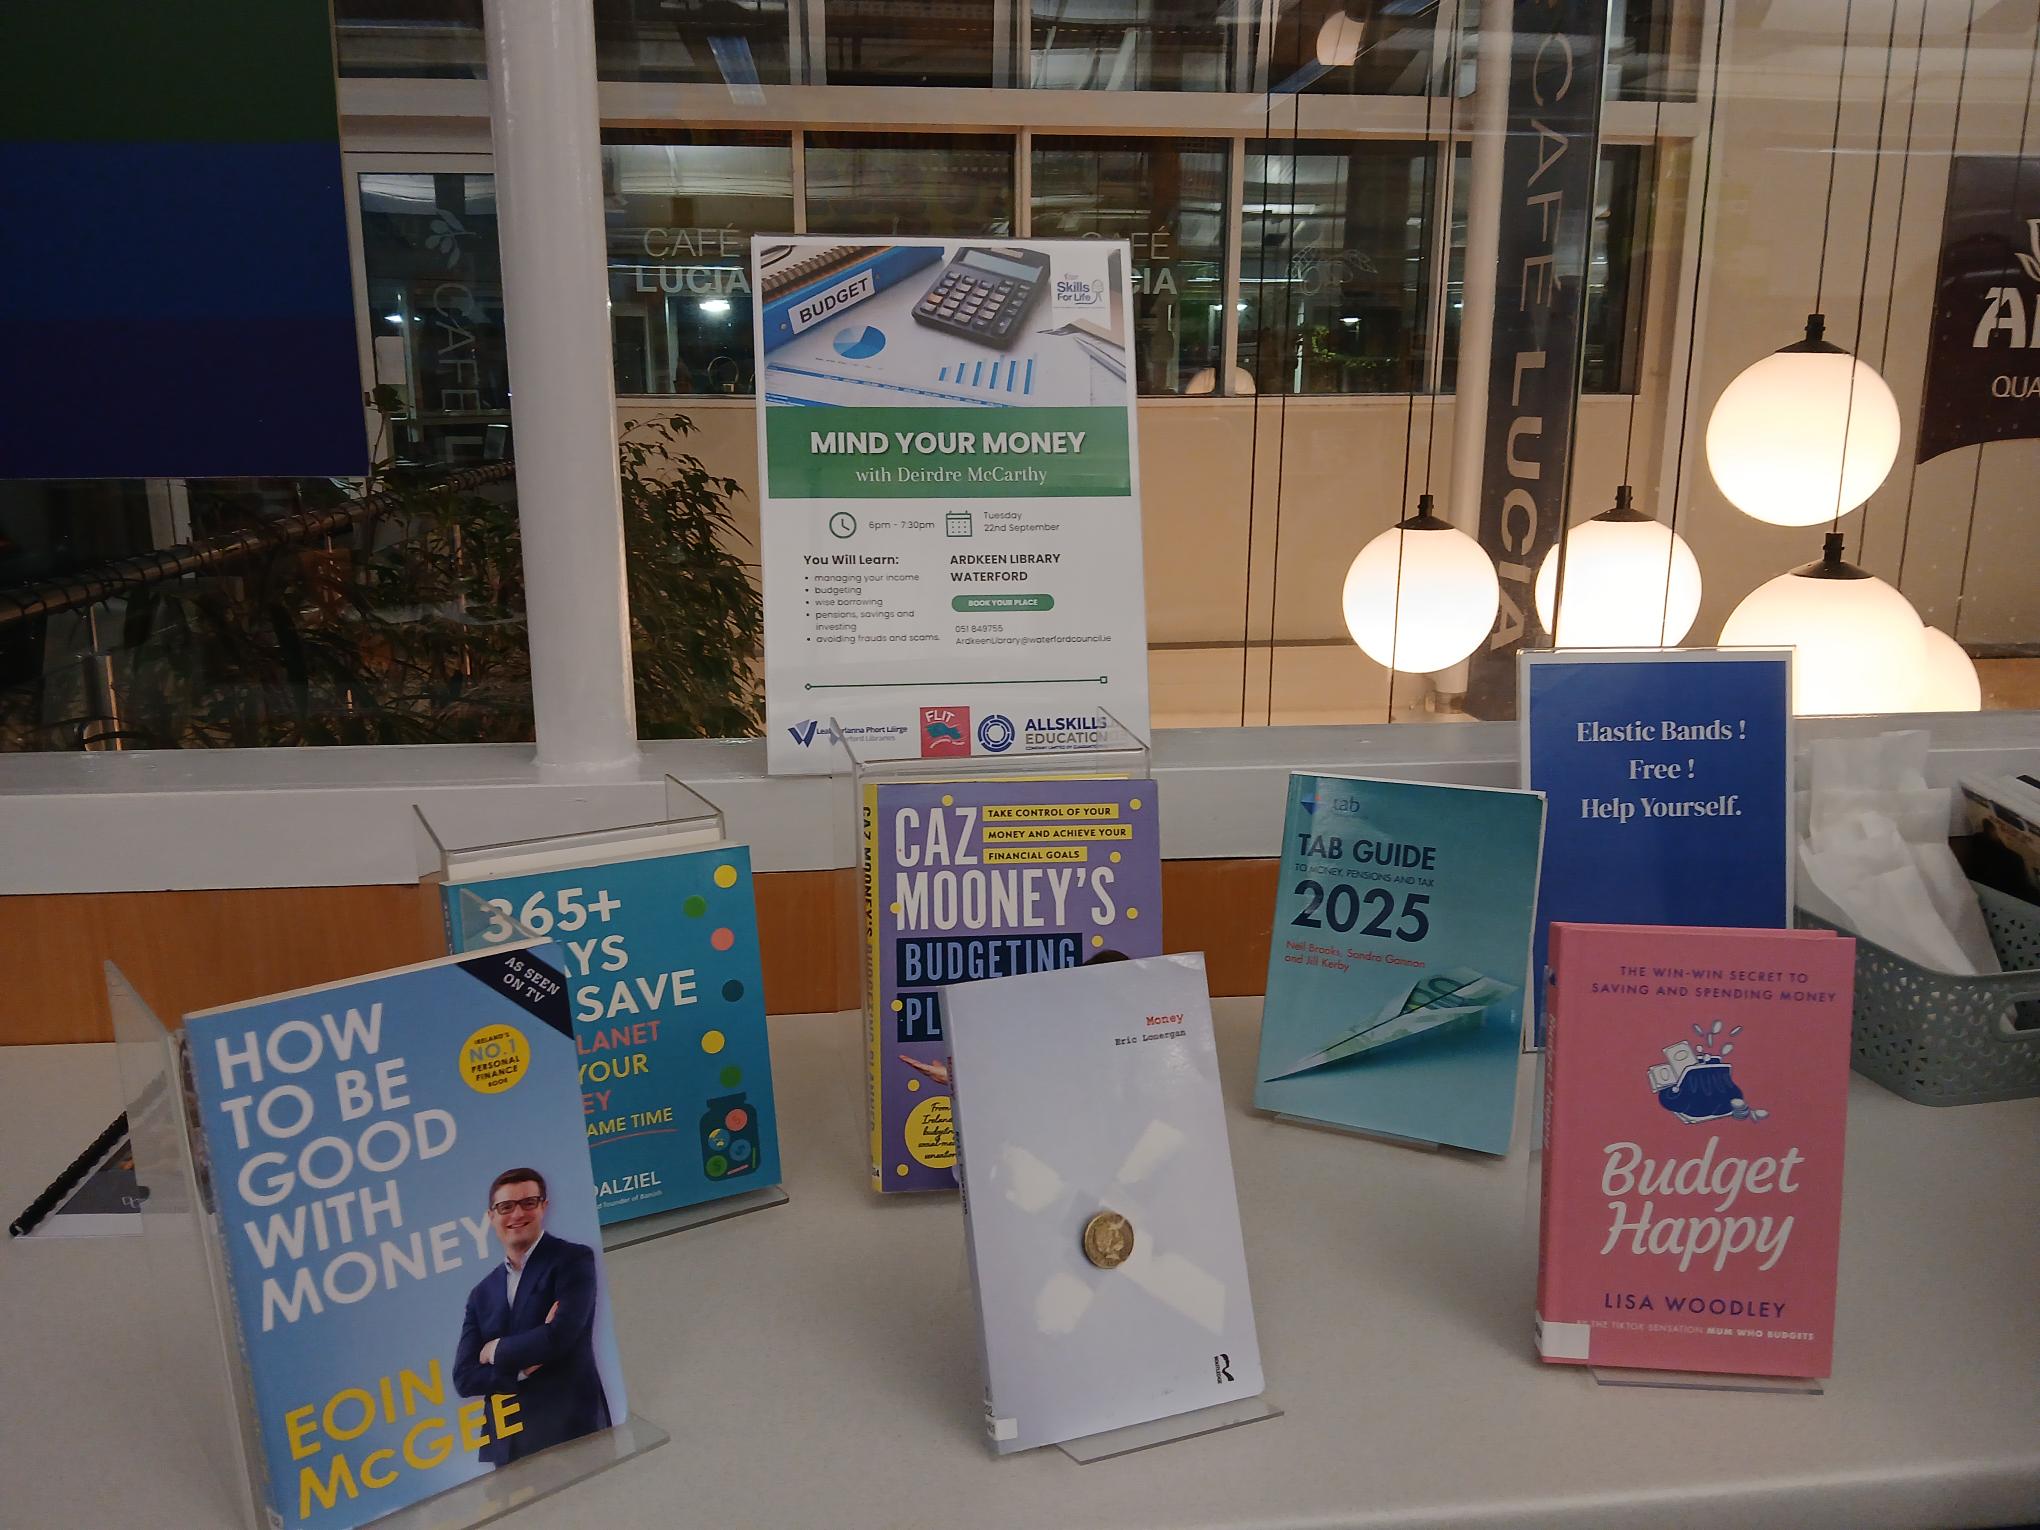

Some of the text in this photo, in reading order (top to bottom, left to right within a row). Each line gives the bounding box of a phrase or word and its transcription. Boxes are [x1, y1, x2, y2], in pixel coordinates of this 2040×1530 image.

[643, 223, 740, 258] CAFÉ
[636, 266, 752, 295] LUCIA
[1057, 281, 1090, 292] Skills
[799, 277, 869, 324] BUDGET
[1057, 293, 1091, 301] For Life
[811, 431, 1086, 455] MIND YOUR MONEY
[856, 467, 1048, 486] with Deirdre McCarthy
[1490, 350, 1546, 651] LUCIA
[869, 521, 891, 531] 6pm
[983, 511, 1022, 521] Tuesday
[983, 522, 1060, 533] 22nd September
[803, 554, 900, 565] You Will Learn:
[950, 553, 1061, 565] ARDKEEN LIBRARY
[814, 575, 862, 583] managing
[863, 575, 883, 583] your
[950, 571, 1028, 582] WATERFORD
[814, 586, 862, 595] budgeting
[837, 599, 883, 607] borrowing
[861, 610, 895, 619] savings
[815, 622, 857, 632] investing
[955, 625, 969, 633] 051
[816, 635, 856, 644] avoiding
[858, 634, 887, 642] frauds
[925, 710, 955, 723] FLIT
[1025, 716, 1106, 732] ALLSKILLS
[1025, 731, 1107, 745] EDUCATION
[1576, 720, 1747, 743] Elastic Bands !
[1628, 759, 1695, 781] Free !
[988, 807, 1111, 818] TAKE CONTROL OF YOUR
[1333, 796, 1360, 813] tab
[1581, 795, 1742, 825] Help Yourself.
[895, 806, 978, 867] CAZ
[988, 827, 1127, 839] MONEY AND ACHIEVE YOUR
[988, 850, 1080, 860] FINANCIAL GOALS
[1298, 833, 1437, 871] TAB GUIDE
[1295, 863, 1308, 872] TO
[1346, 868, 1391, 883] PENSIONS
[1394, 876, 1415, 885] AND
[1418, 877, 1434, 887] TAX
[896, 866, 1116, 931] MOONEY'S
[480, 887, 622, 944] 365+
[1291, 879, 1430, 943] 2025
[905, 938, 1075, 981] BUDGETING
[1284, 954, 1303, 964] and
[504, 956, 561, 996] AS SEEN
[1620, 966, 1809, 984] THE WIN-WIN SECRET TO
[503, 973, 546, 1003] ON TV
[576, 968, 698, 1023] SAVE
[1592, 982, 1836, 1003] SAVING AND SPENDING MONEY
[1146, 1013, 1184, 1026] Money
[215, 1002, 384, 1090] HOW
[576, 1020, 661, 1056] LANET
[1114, 1029, 1187, 1046] Eric Lonergan
[471, 1055, 521, 1074] PERSONAL
[476, 1065, 518, 1081] FINANCE
[220, 1057, 411, 1150] TO BE
[587, 1107, 673, 1138] AME TIME
[237, 1108, 458, 1207] GOOD
[1601, 1136, 1805, 1213] Budget
[243, 1179, 403, 1270] WITH
[1600, 1200, 1795, 1273] Happy
[261, 1211, 494, 1332] MONEY
[1604, 1293, 1786, 1319] LISA WOODLEY
[1706, 1327, 1733, 1336] MUM
[1737, 1328, 1763, 1338] WHO
[1767, 1330, 1815, 1341] BUDGETS
[285, 1358, 445, 1461] EOIN
